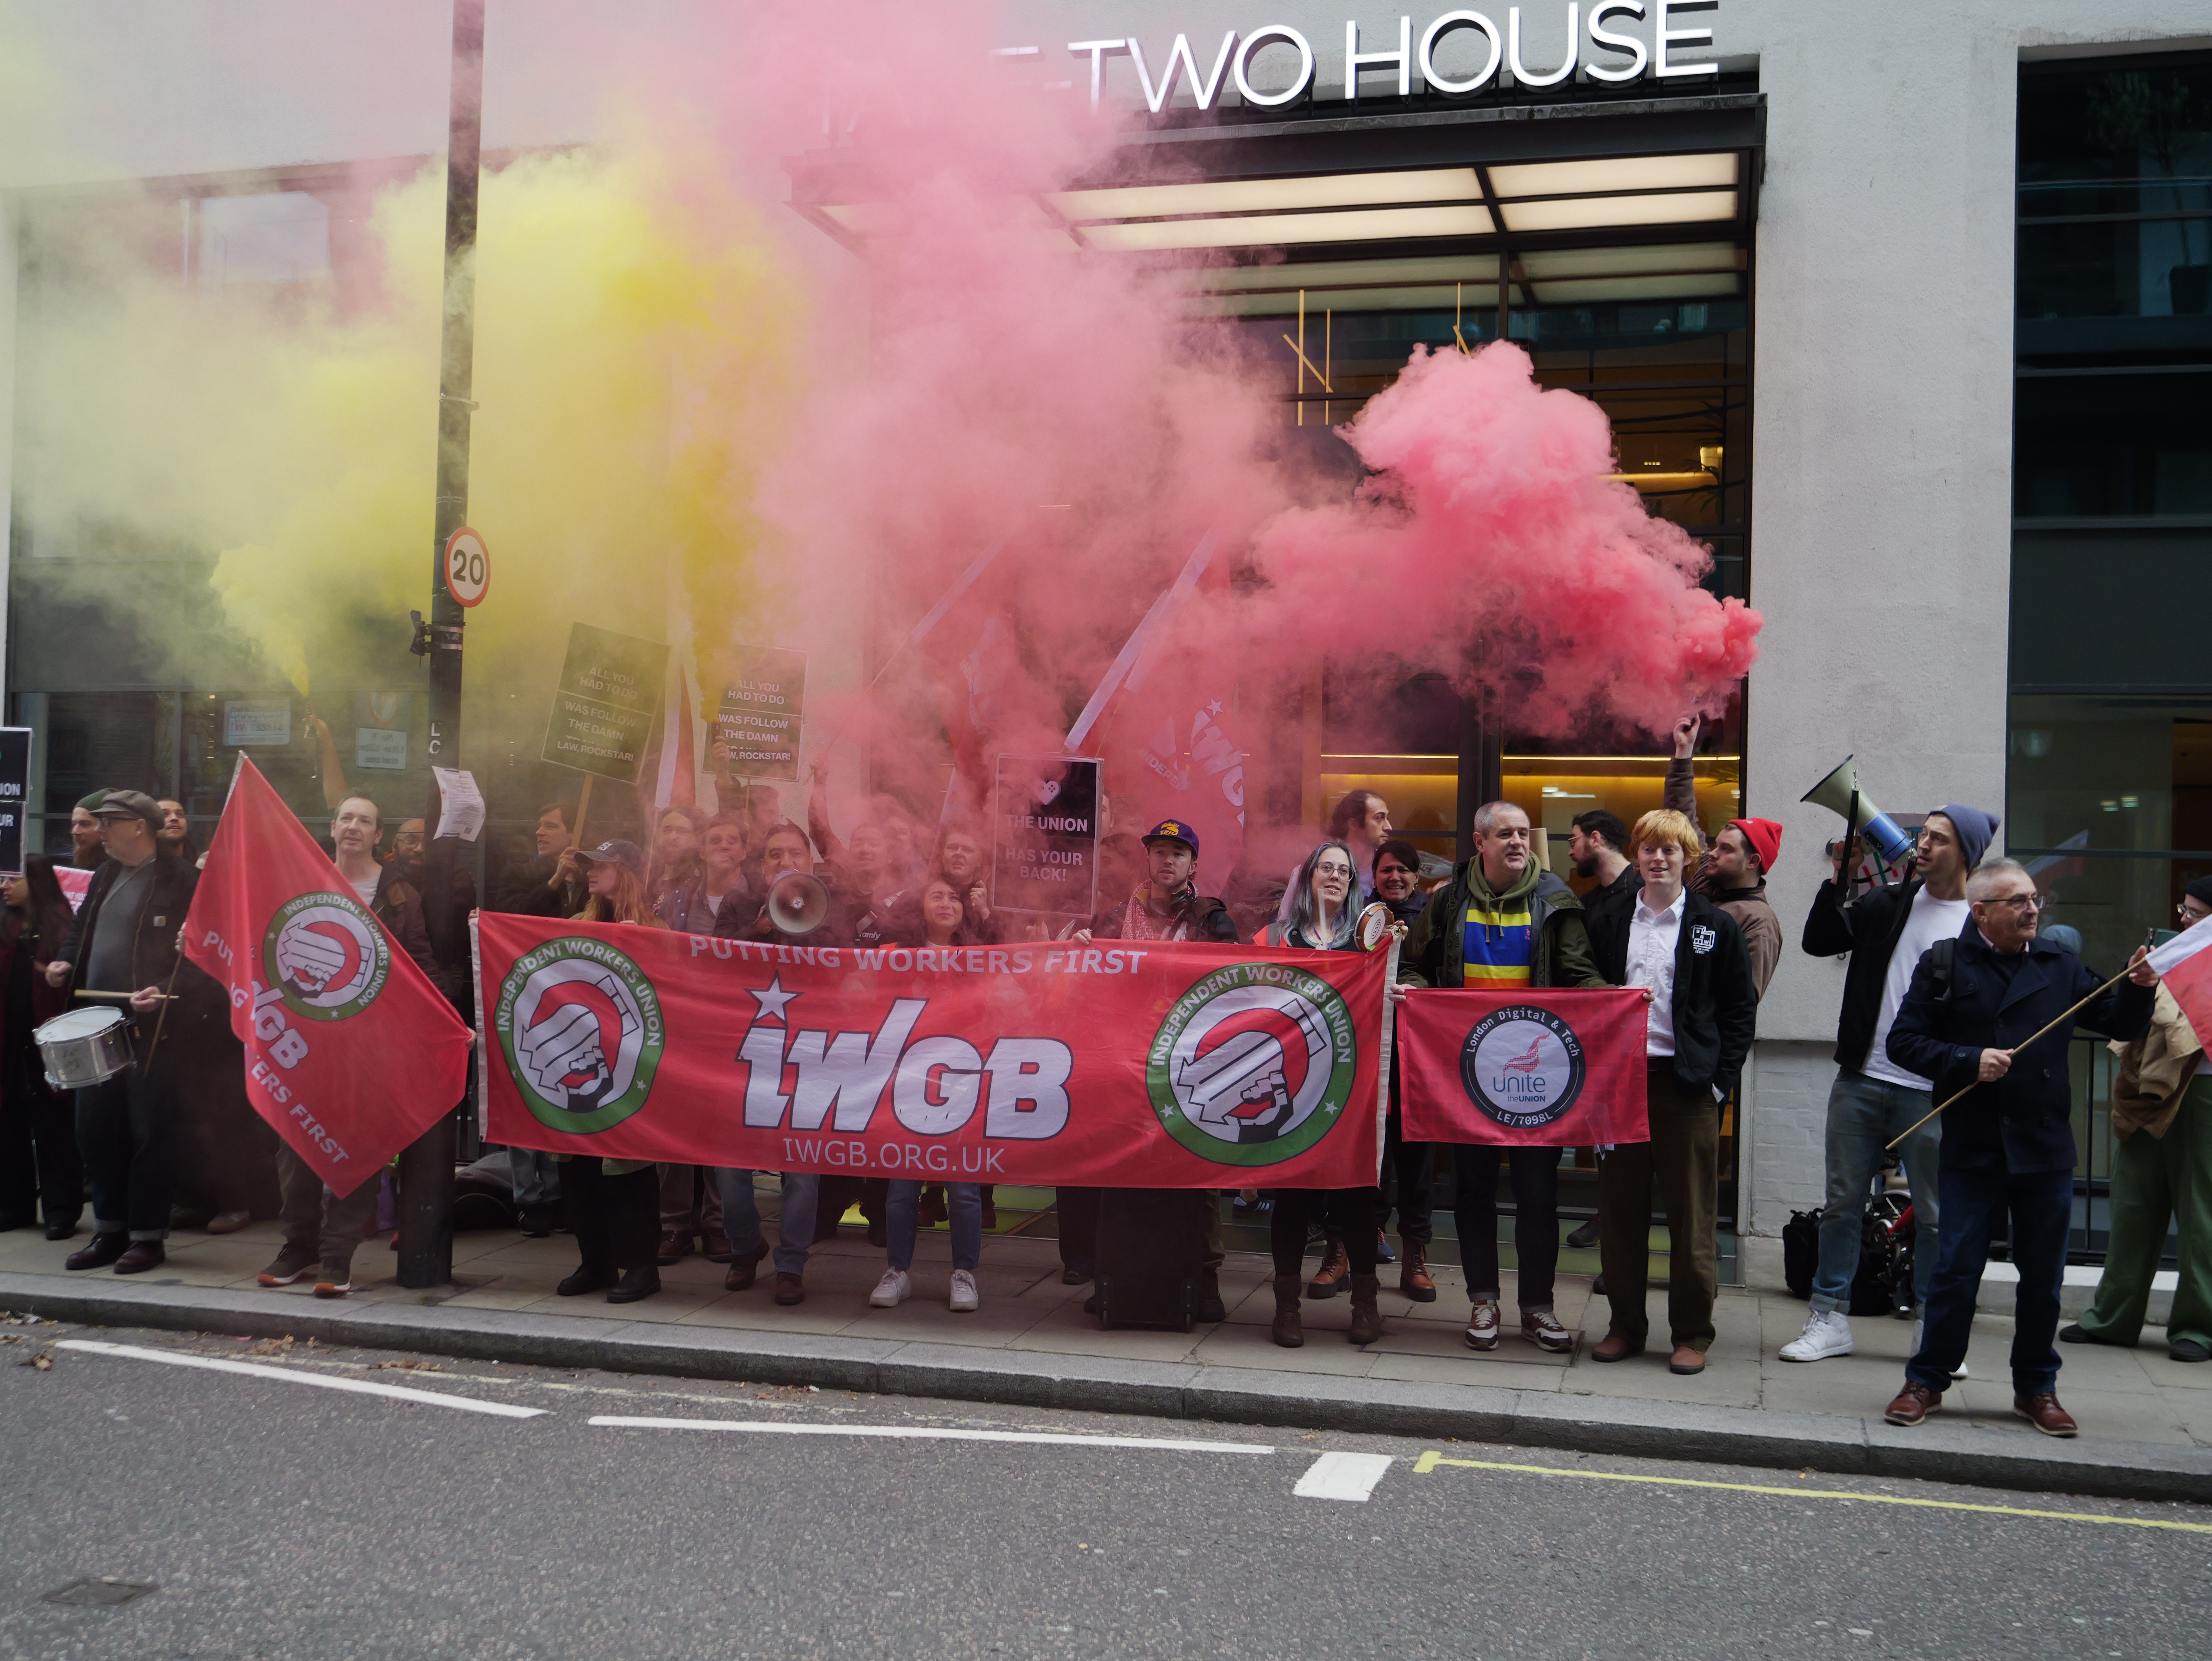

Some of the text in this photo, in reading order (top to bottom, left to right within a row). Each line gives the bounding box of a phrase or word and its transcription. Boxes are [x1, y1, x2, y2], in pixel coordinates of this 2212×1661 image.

[1068, 25, 1313, 114] TWO
[1345, 0, 1718, 99] HOUSE
[453, 549, 484, 585] 20
[589, 667, 634, 685] ALL YOU
[579, 677, 638, 699] HAD TO DO
[728, 690, 784, 704] HAD TO DO
[758, 682, 779, 692] YOU
[565, 701, 637, 727] WAS FOLLOW
[718, 714, 788, 729] WAS FOLLOW
[568, 718, 590, 732] THE
[591, 725, 624, 741] DAMN
[724, 729, 778, 743] THE DAMN
[557, 741, 634, 761] LAW, ROCKSTAR!
[740, 752, 790, 760] ROCKSTAR!
[0, 783, 21, 796] ION
[1006, 815, 1087, 832] THE UNION
[1006, 847, 1082, 865] HAS YOUR
[1020, 866, 1066, 881] BACK!
[283, 894, 388, 1006] INDEPENDENT WORKERS UNION
[690, 935, 1147, 975] PUTTING WORKERS FIRST
[498, 941, 661, 1046] INDEPENDENT WORKERS UNION
[1151, 966, 1351, 1065] INDEPENDENT WORKERS UNION
[1466, 1007, 1580, 1057] London Digital & Tech
[1497, 1111, 1553, 1126] LE/7098L
[289, 1103, 350, 1163] FIRST
[783, 1138, 1005, 1173] IWGB.ORG.UK
